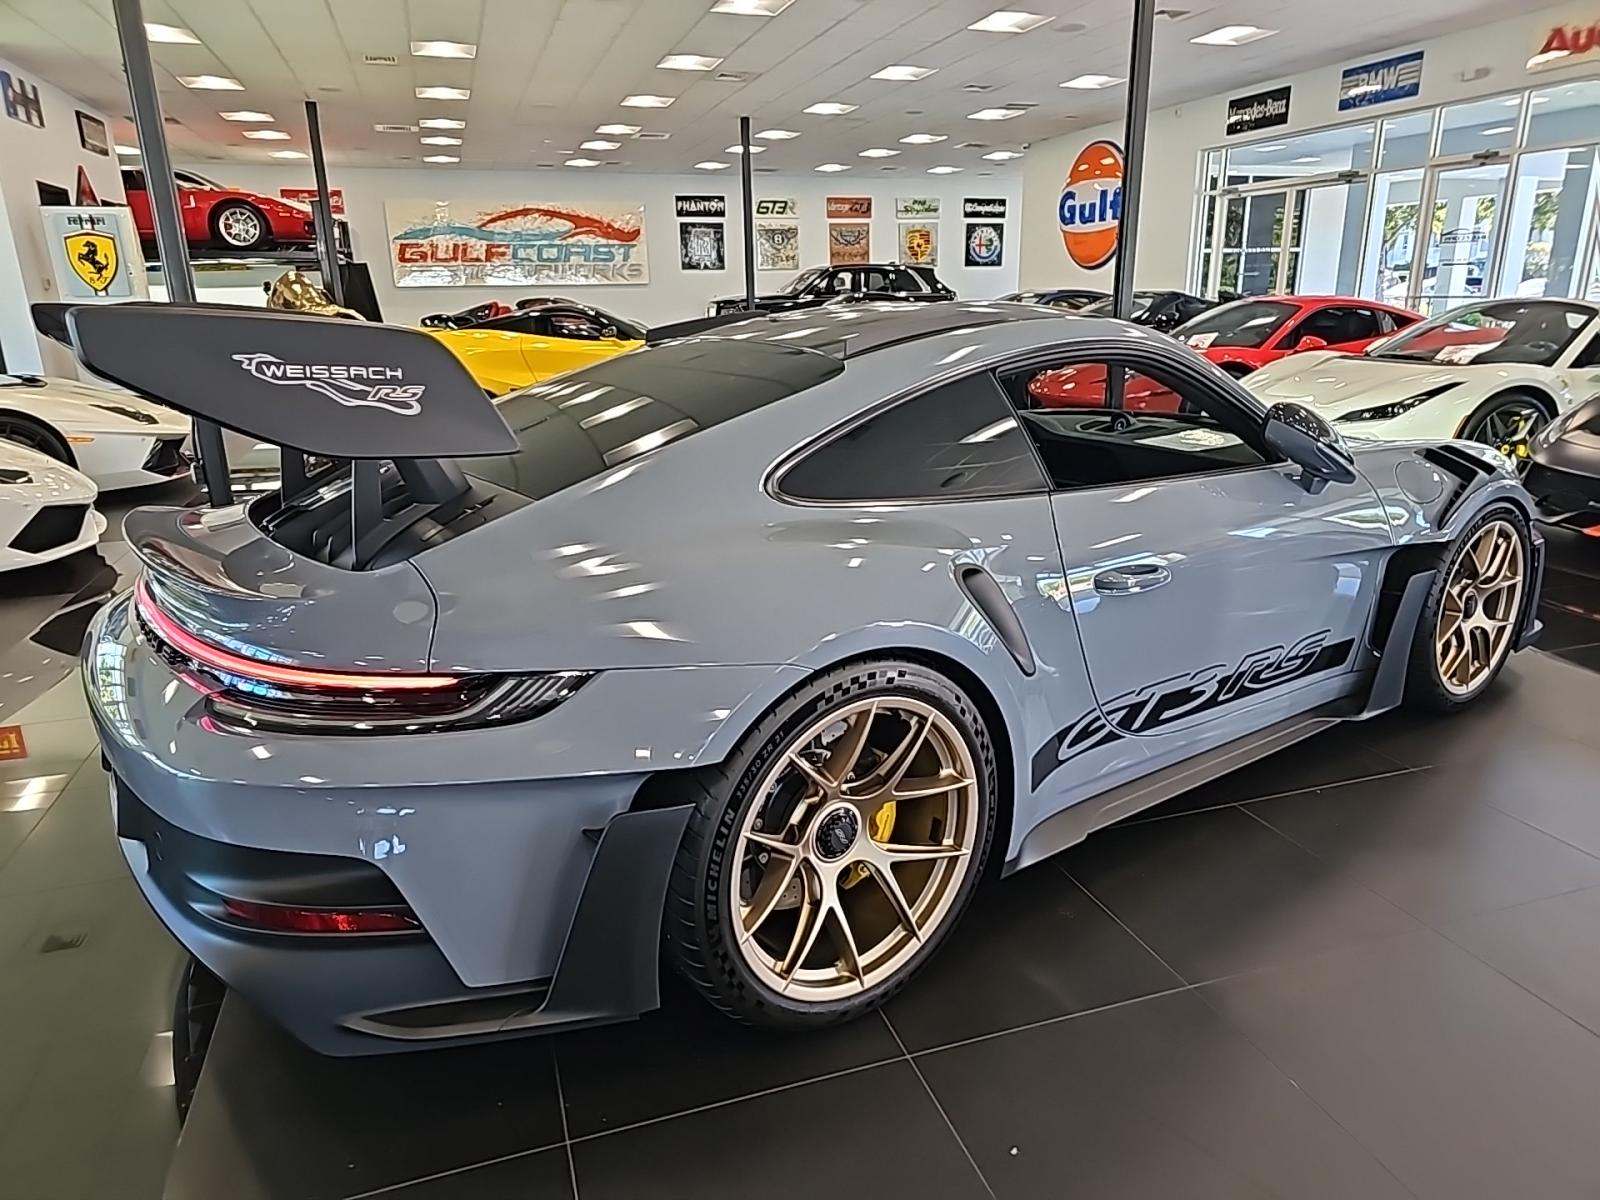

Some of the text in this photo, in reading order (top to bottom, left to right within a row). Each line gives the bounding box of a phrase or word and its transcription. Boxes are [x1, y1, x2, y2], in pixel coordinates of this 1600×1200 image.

[1058, 186, 1123, 226] Gulf
[262, 363, 403, 380] WEISSACH
[367, 384, 425, 401] RS
[1217, 629, 1332, 701] RS
[706, 808, 736, 922] MICHELIN
